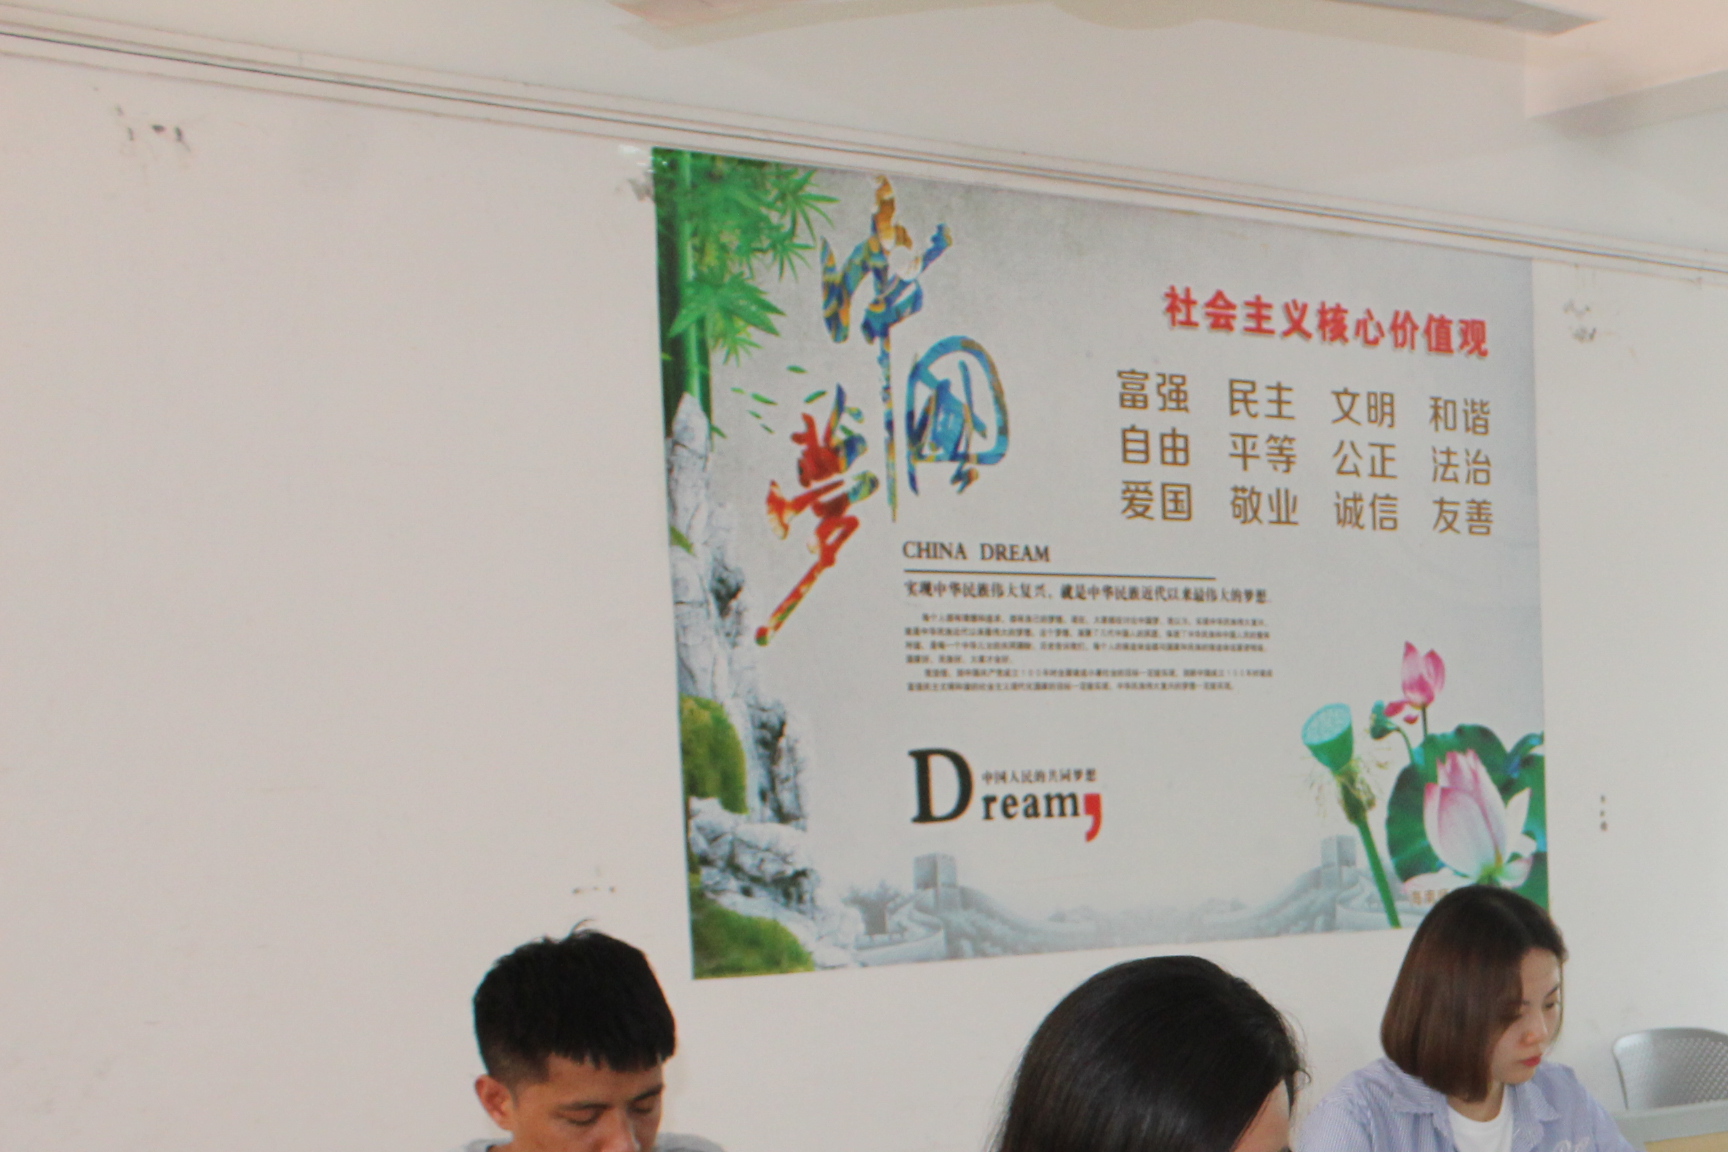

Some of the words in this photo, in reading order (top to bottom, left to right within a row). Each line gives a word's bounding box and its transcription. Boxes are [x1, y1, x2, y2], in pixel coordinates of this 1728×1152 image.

[1164, 285, 1490, 358] 社会主义核心价值观
[1117, 368, 1191, 414] 富强
[1228, 378, 1296, 421] 民主
[1330, 386, 1397, 429] 文明
[1429, 395, 1491, 436] 和谐
[1120, 424, 1191, 467] 自由
[1228, 432, 1297, 474] 平等
[1331, 439, 1399, 480] 公正
[1431, 445, 1493, 487] 法治
[1120, 479, 1193, 523] 爱国
[1229, 485, 1300, 526] 敬业
[1333, 490, 1399, 532] 诚信
[1432, 496, 1494, 537] 友善
[902, 540, 968, 561] CHINA
[980, 543, 1052, 563] DREAM
[981, 768, 1097, 785] 中国人民的共同梦想
